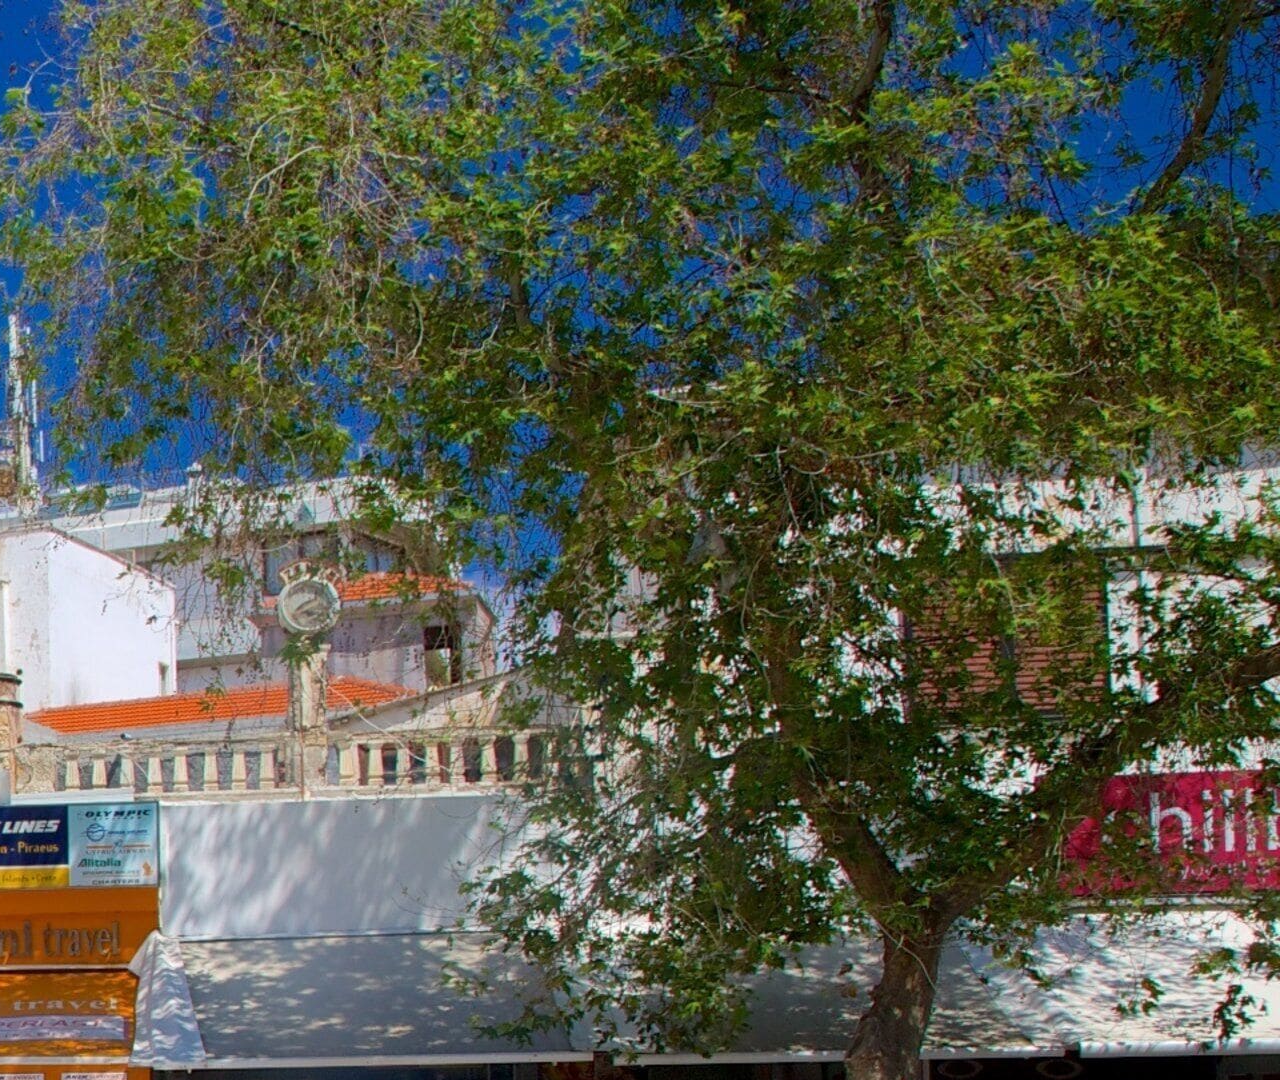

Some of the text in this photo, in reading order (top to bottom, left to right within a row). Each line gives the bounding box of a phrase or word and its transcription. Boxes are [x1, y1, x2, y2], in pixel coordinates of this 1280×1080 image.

[85, 809, 152, 818] OLYMPIC
[2, 819, 60, 835] LINES
[17, 840, 60, 854] Piraeus
[77, 857, 122, 868] Alitalia
[43, 920, 120, 956] travel
[14, 997, 118, 1011] travel
